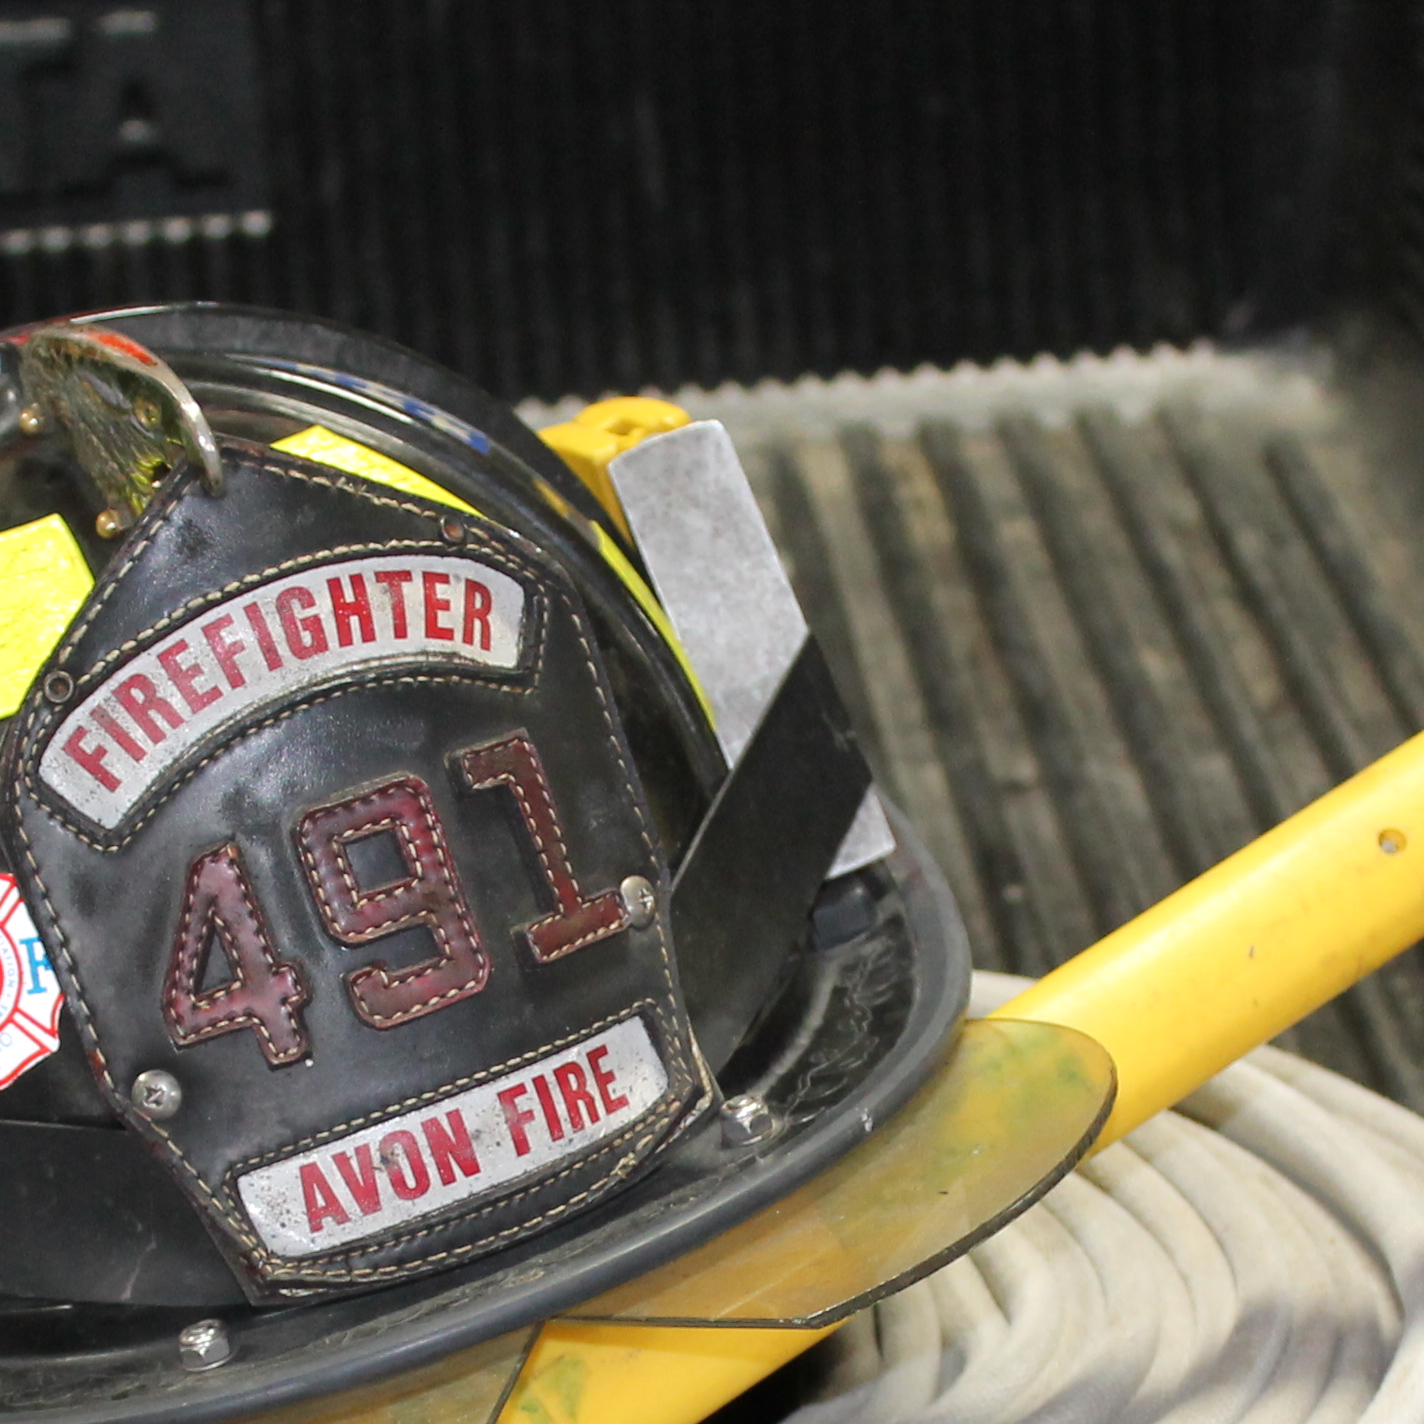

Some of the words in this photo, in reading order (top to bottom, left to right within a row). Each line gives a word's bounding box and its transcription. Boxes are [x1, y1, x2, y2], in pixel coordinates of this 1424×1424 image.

[61, 569, 493, 793] FIREFIGHTER
[163, 727, 630, 1068] 491
[297, 1108, 482, 1234] AVON
[496, 1044, 630, 1159] FIRE
